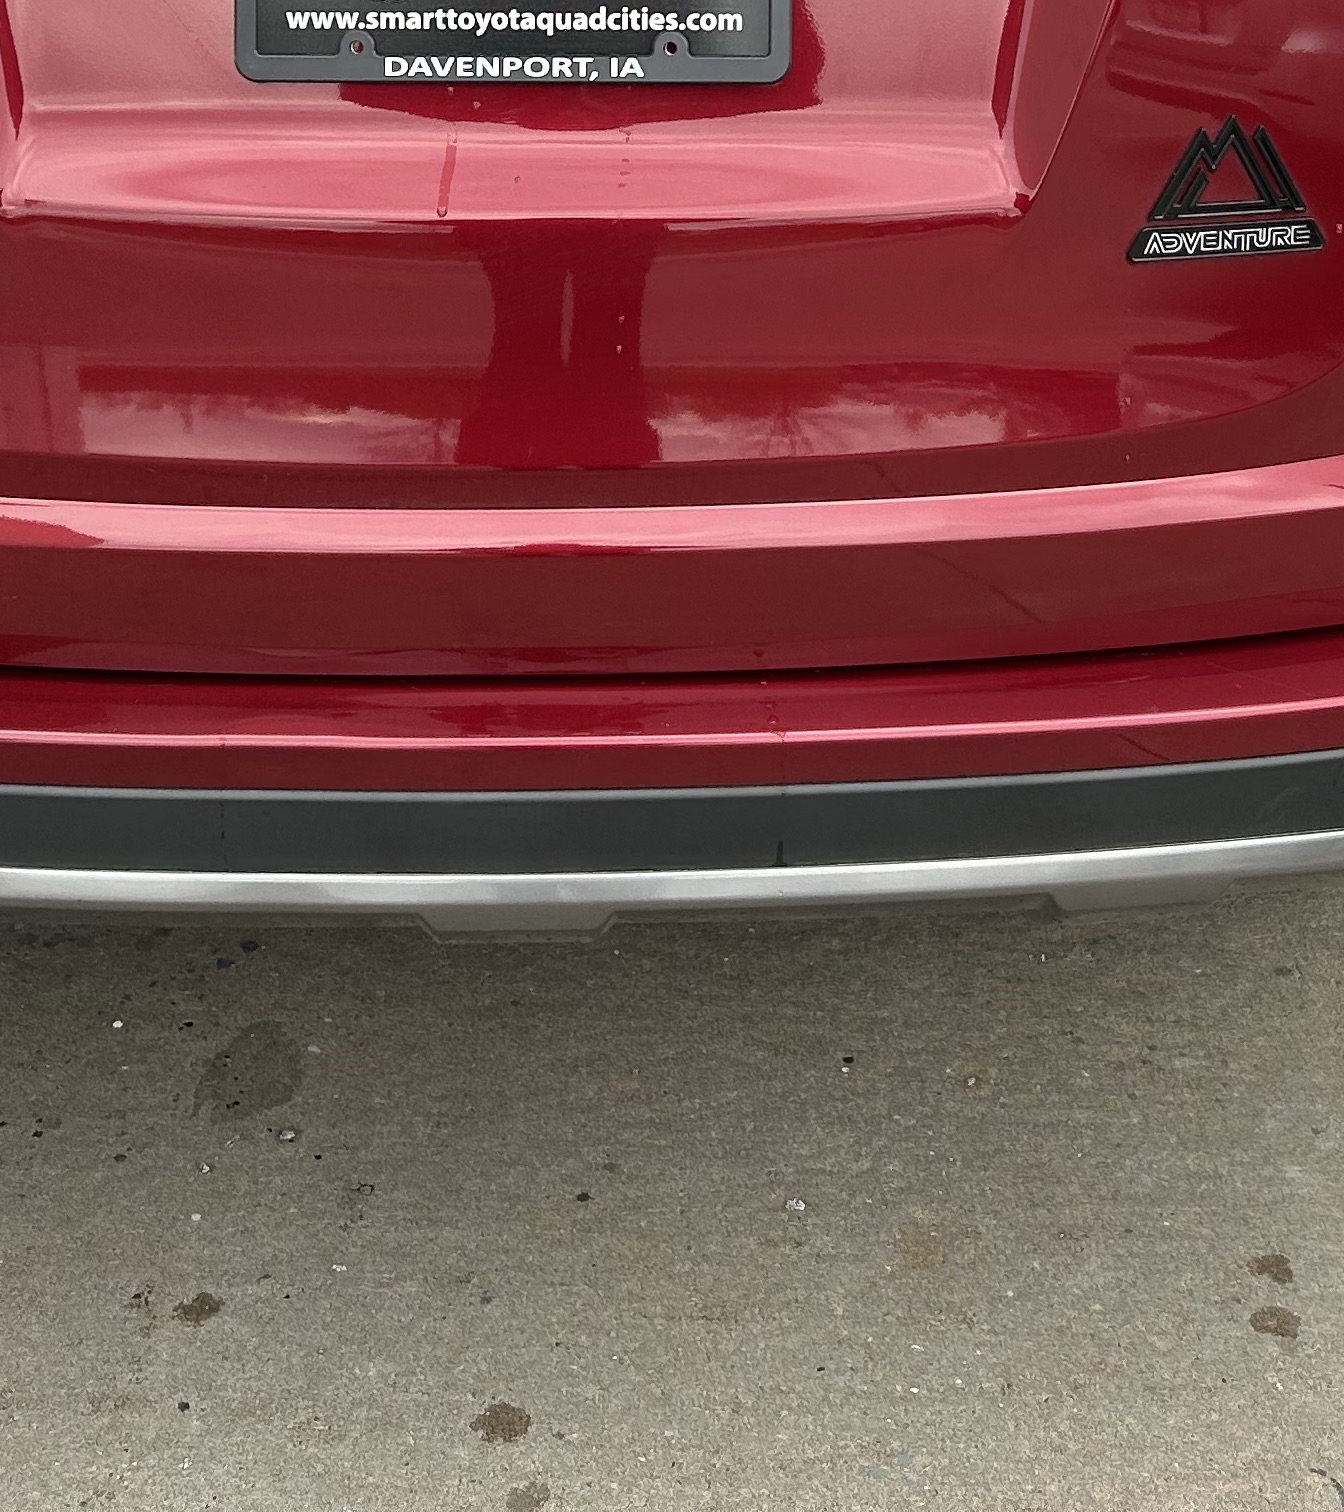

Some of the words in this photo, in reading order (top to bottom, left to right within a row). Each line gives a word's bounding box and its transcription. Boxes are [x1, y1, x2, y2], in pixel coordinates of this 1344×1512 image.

[285, 7, 744, 37] www.smarttoyotaquadcities.com
[383, 56, 599, 82] DAVENPORT,
[609, 56, 645, 78] IA
[1143, 225, 1312, 255] ADVENTURE
